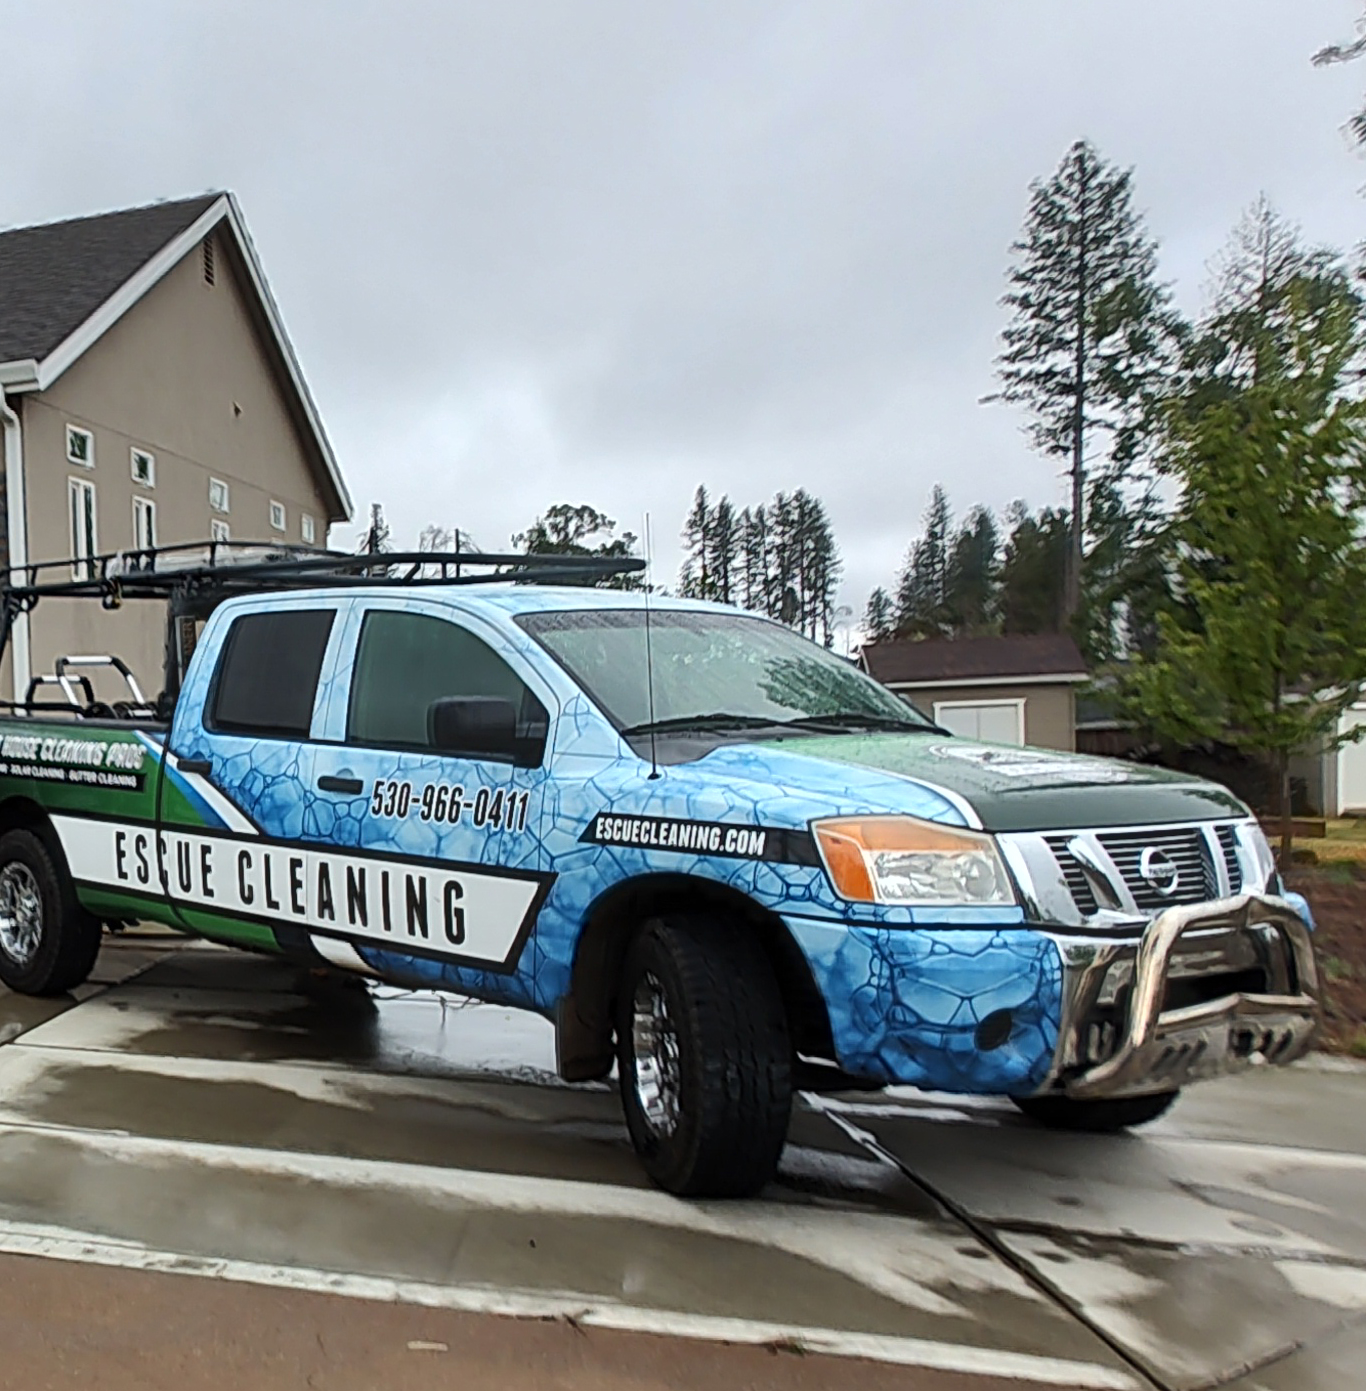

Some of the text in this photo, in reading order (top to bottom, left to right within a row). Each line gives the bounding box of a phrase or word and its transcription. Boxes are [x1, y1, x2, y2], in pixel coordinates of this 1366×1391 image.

[1, 736, 42, 760] HOUSE
[39, 738, 109, 767] CLEANING
[105, 742, 148, 770] PROS
[97, 772, 137, 788] CLEANING
[371, 780, 529, 831] 530-966-0411
[595, 816, 766, 857] ESCUECLEANING.COM
[115, 830, 466, 946] ESCUE CLEANING
